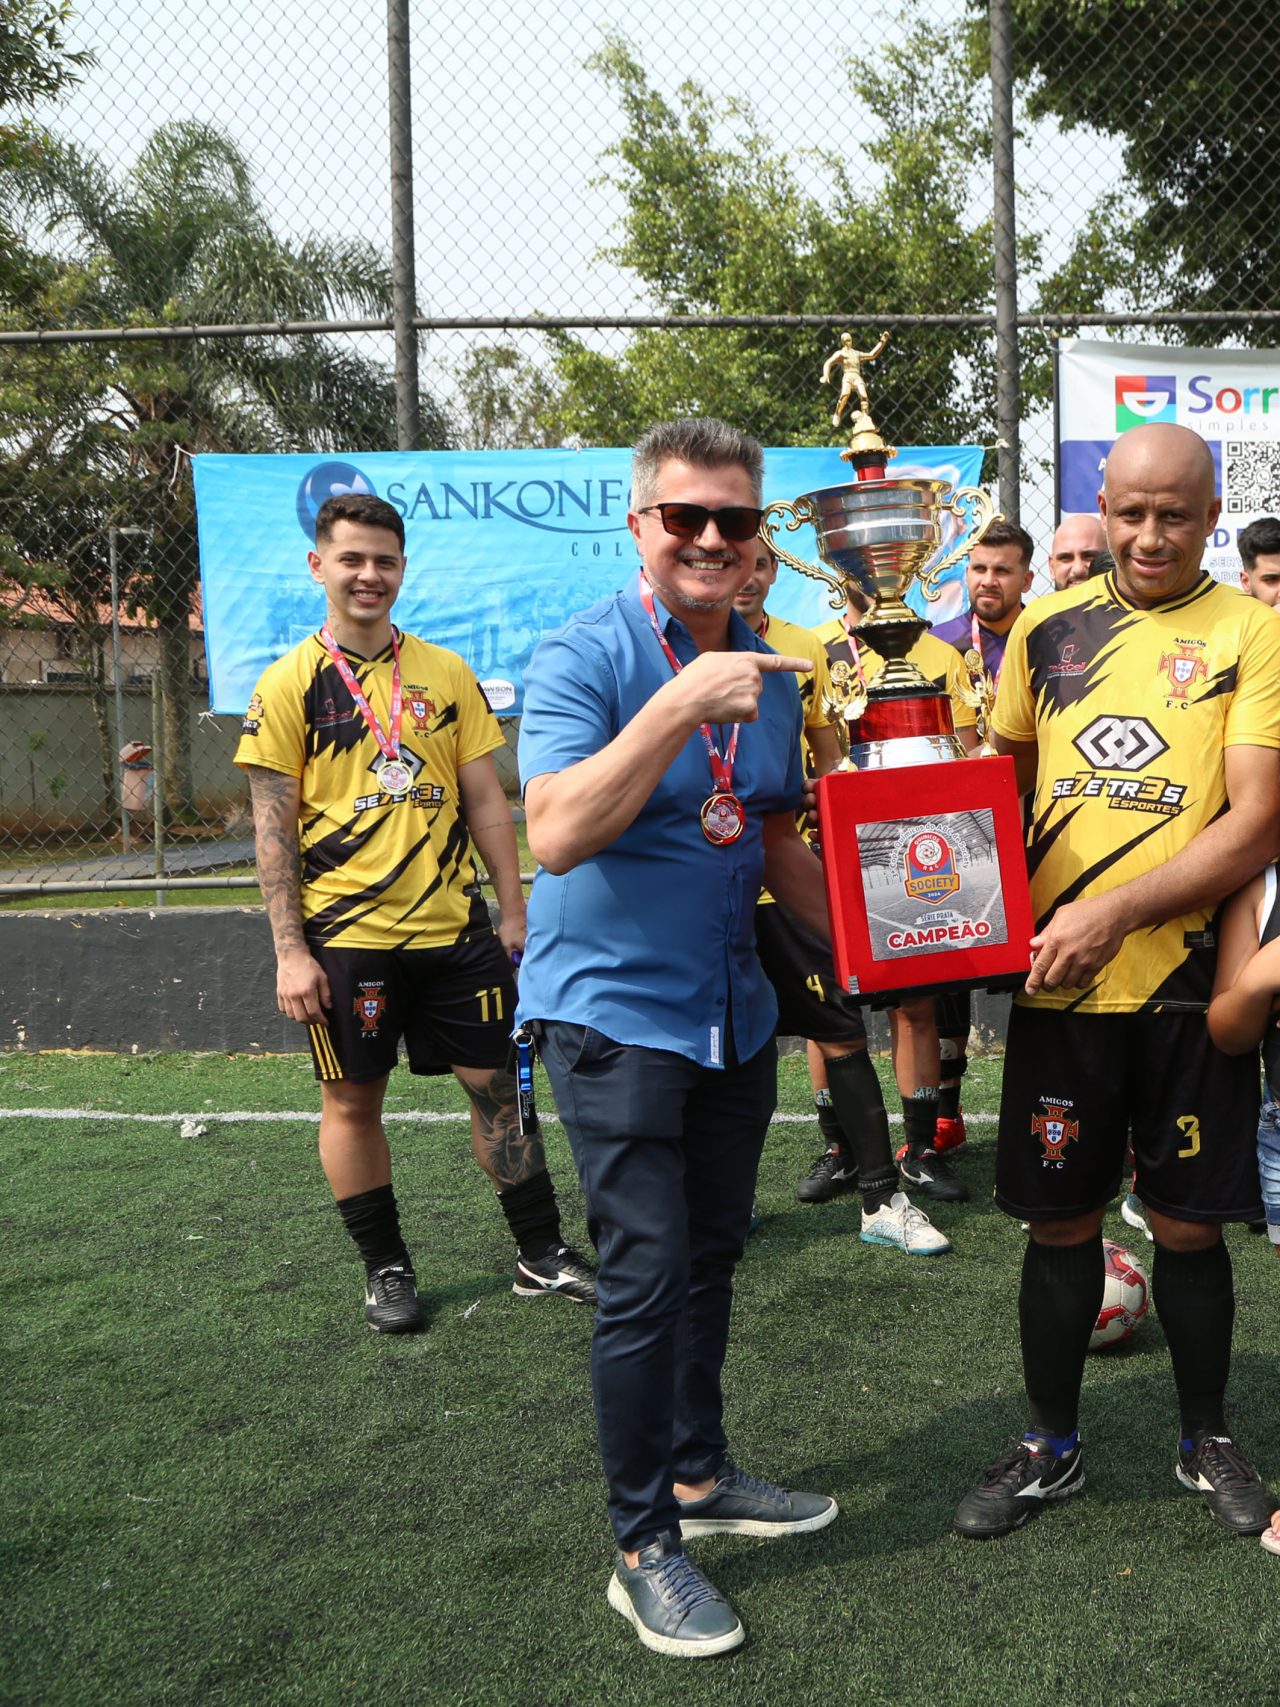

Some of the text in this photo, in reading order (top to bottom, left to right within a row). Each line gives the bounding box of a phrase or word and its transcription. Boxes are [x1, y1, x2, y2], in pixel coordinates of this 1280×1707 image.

[386, 480, 634, 534] SANKONF
[1174, 637, 1207, 647] AMIGOS
[1052, 772, 1187, 804] SE7E TR3S
[1110, 797, 1181, 815] ESPORTES
[936, 823, 954, 836] ABC
[910, 877, 955, 892] SOCIETY
[936, 911, 953, 920] PRATA
[888, 920, 990, 949] CAMPEÃO
[805, 973, 826, 1003] 4
[475, 987, 504, 1022] 11
[1039, 1095, 1074, 1107] AMIGOS
[1176, 1115, 1200, 1158] 3
